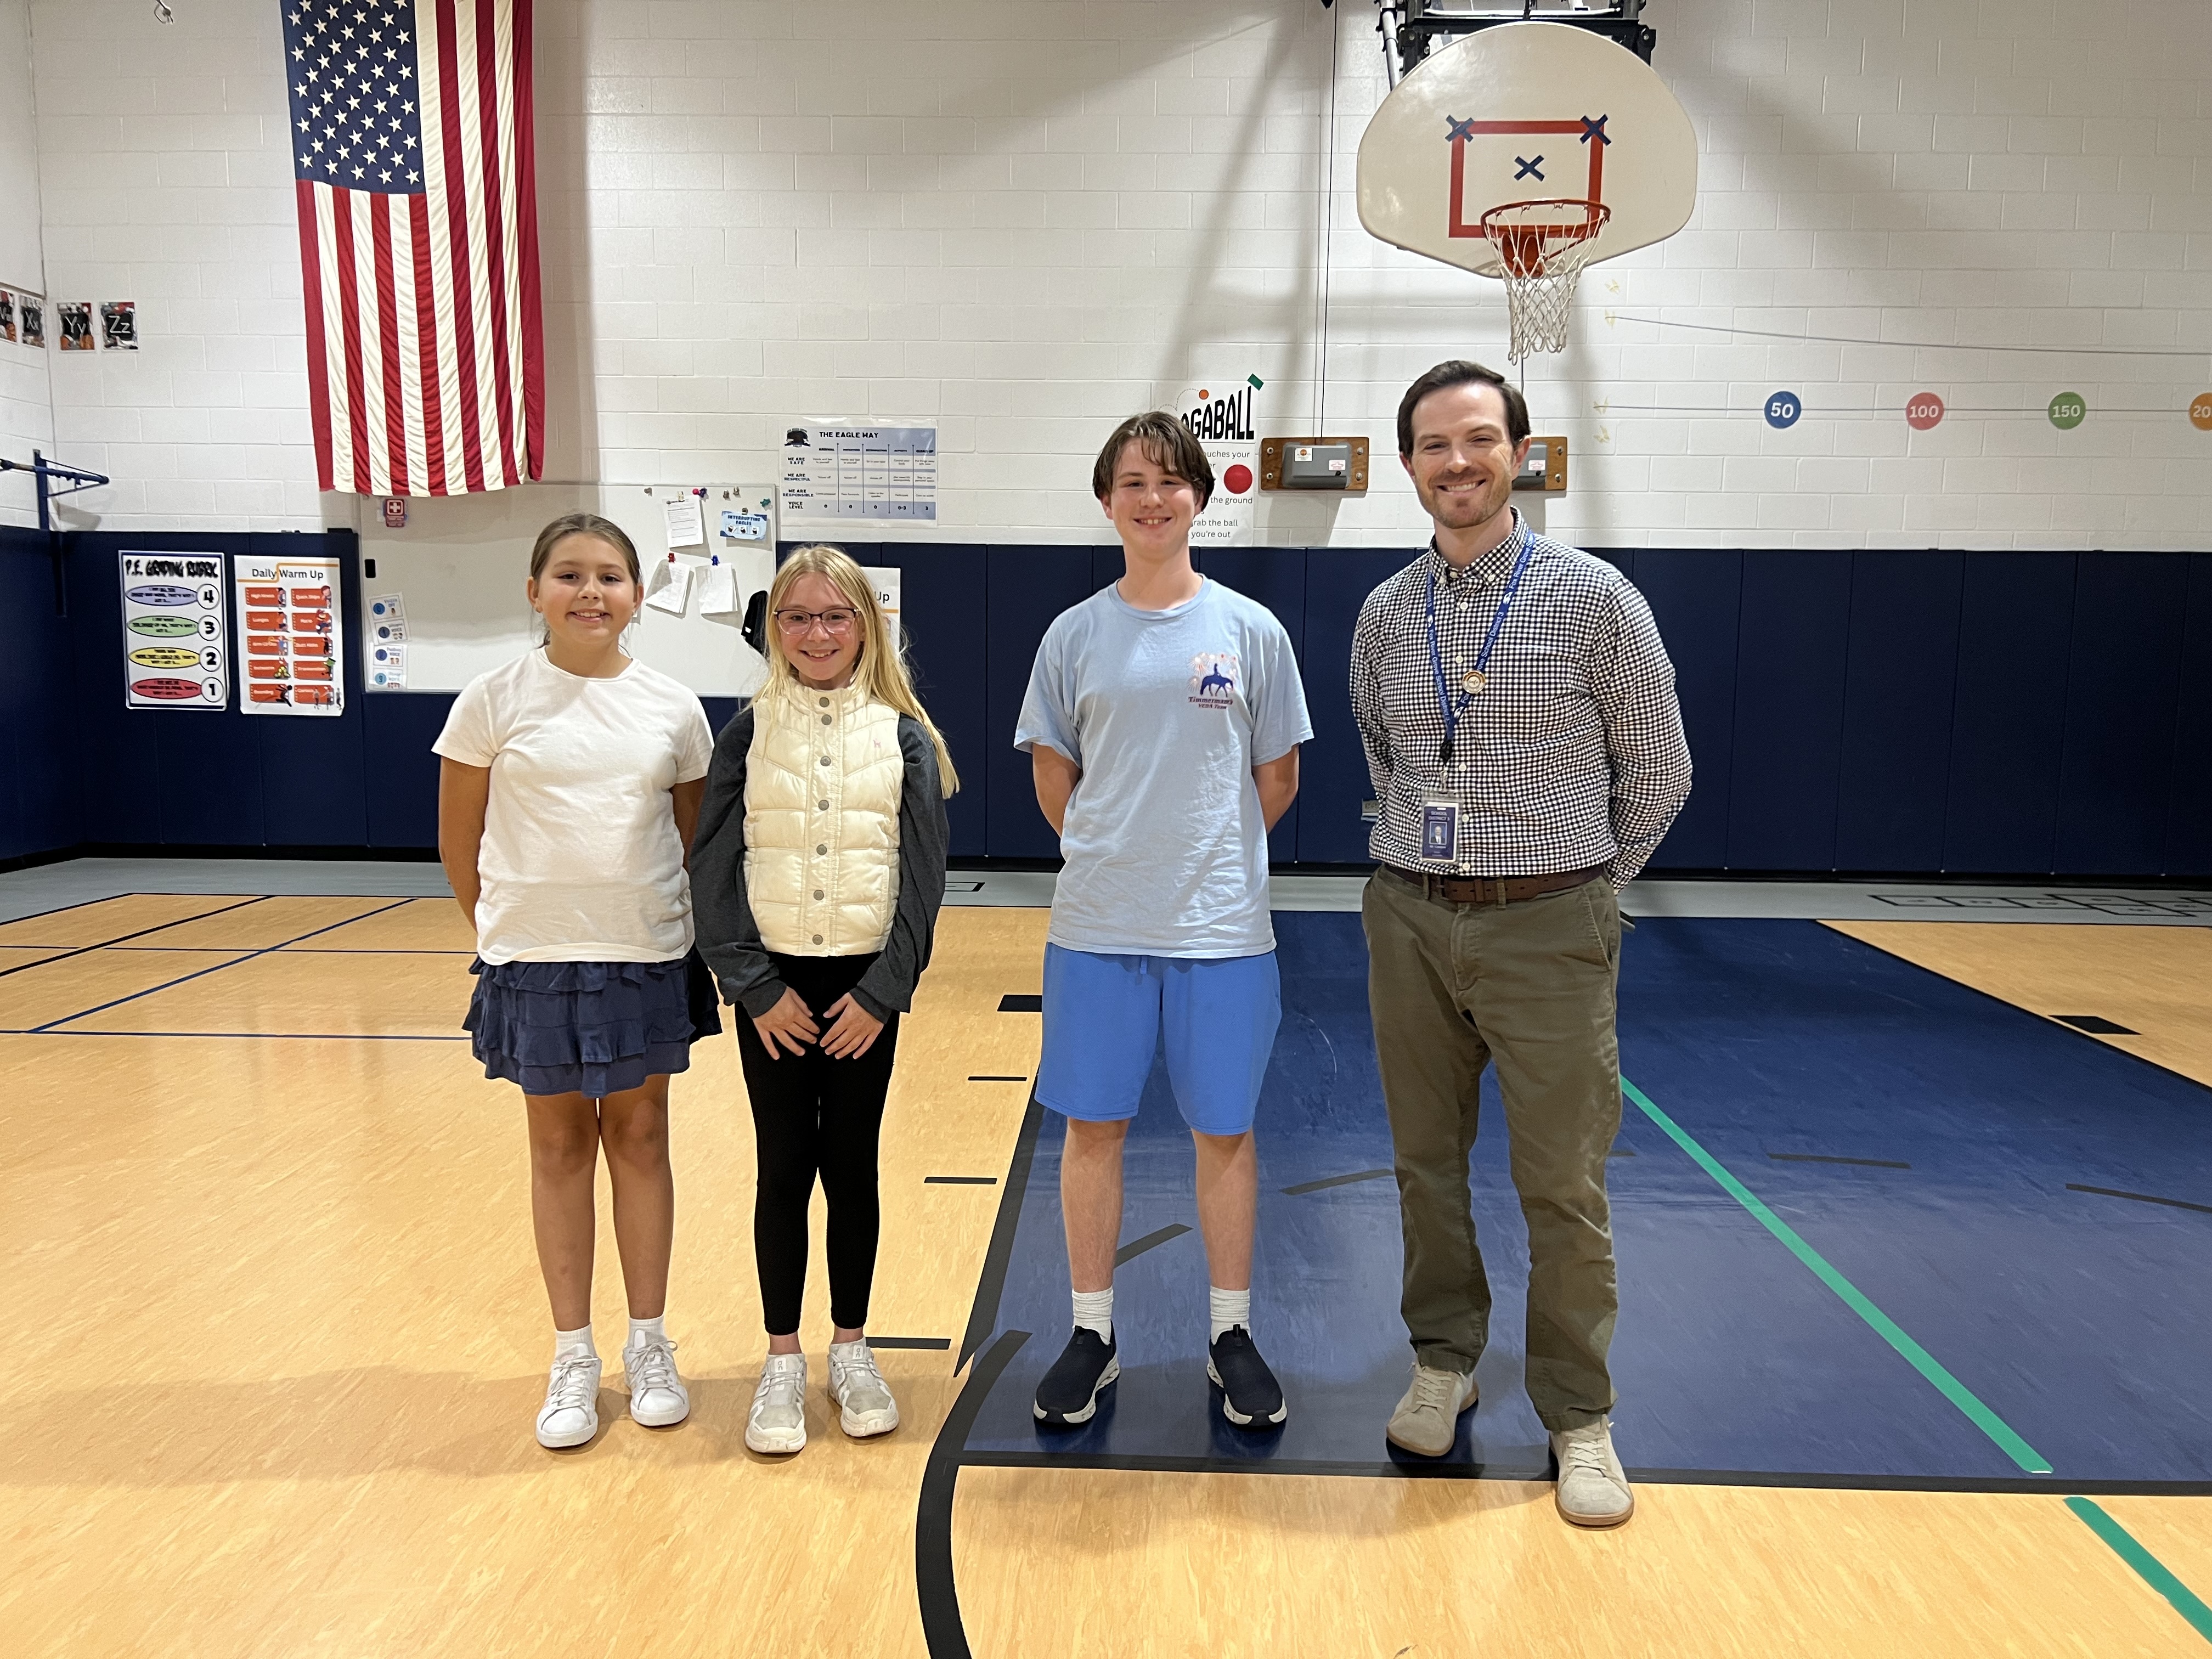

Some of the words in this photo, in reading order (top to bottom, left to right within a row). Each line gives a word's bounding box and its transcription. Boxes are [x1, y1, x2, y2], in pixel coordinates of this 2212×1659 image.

[64, 315, 87, 336] Yy
[108, 315, 132, 334] Zz
[1770, 402, 1795, 419] 50
[1909, 405, 1939, 418] 100
[2052, 405, 2081, 418] 150
[2193, 405, 2212, 418] 20
[1225, 497, 1252, 505] ground
[1191, 530, 1216, 539] you're
[252, 568, 277, 580] Daily
[278, 569, 307, 579] Warm
[310, 571, 324, 580] Up
[204, 590, 214, 603] 4
[874, 591, 890, 603] Up
[204, 621, 215, 635] 3
[1481, 637, 1493, 658] School
[1489, 616, 1502, 637] District
[206, 652, 217, 665] 2
[208, 683, 216, 696] 1
[1435, 675, 1446, 696] School
